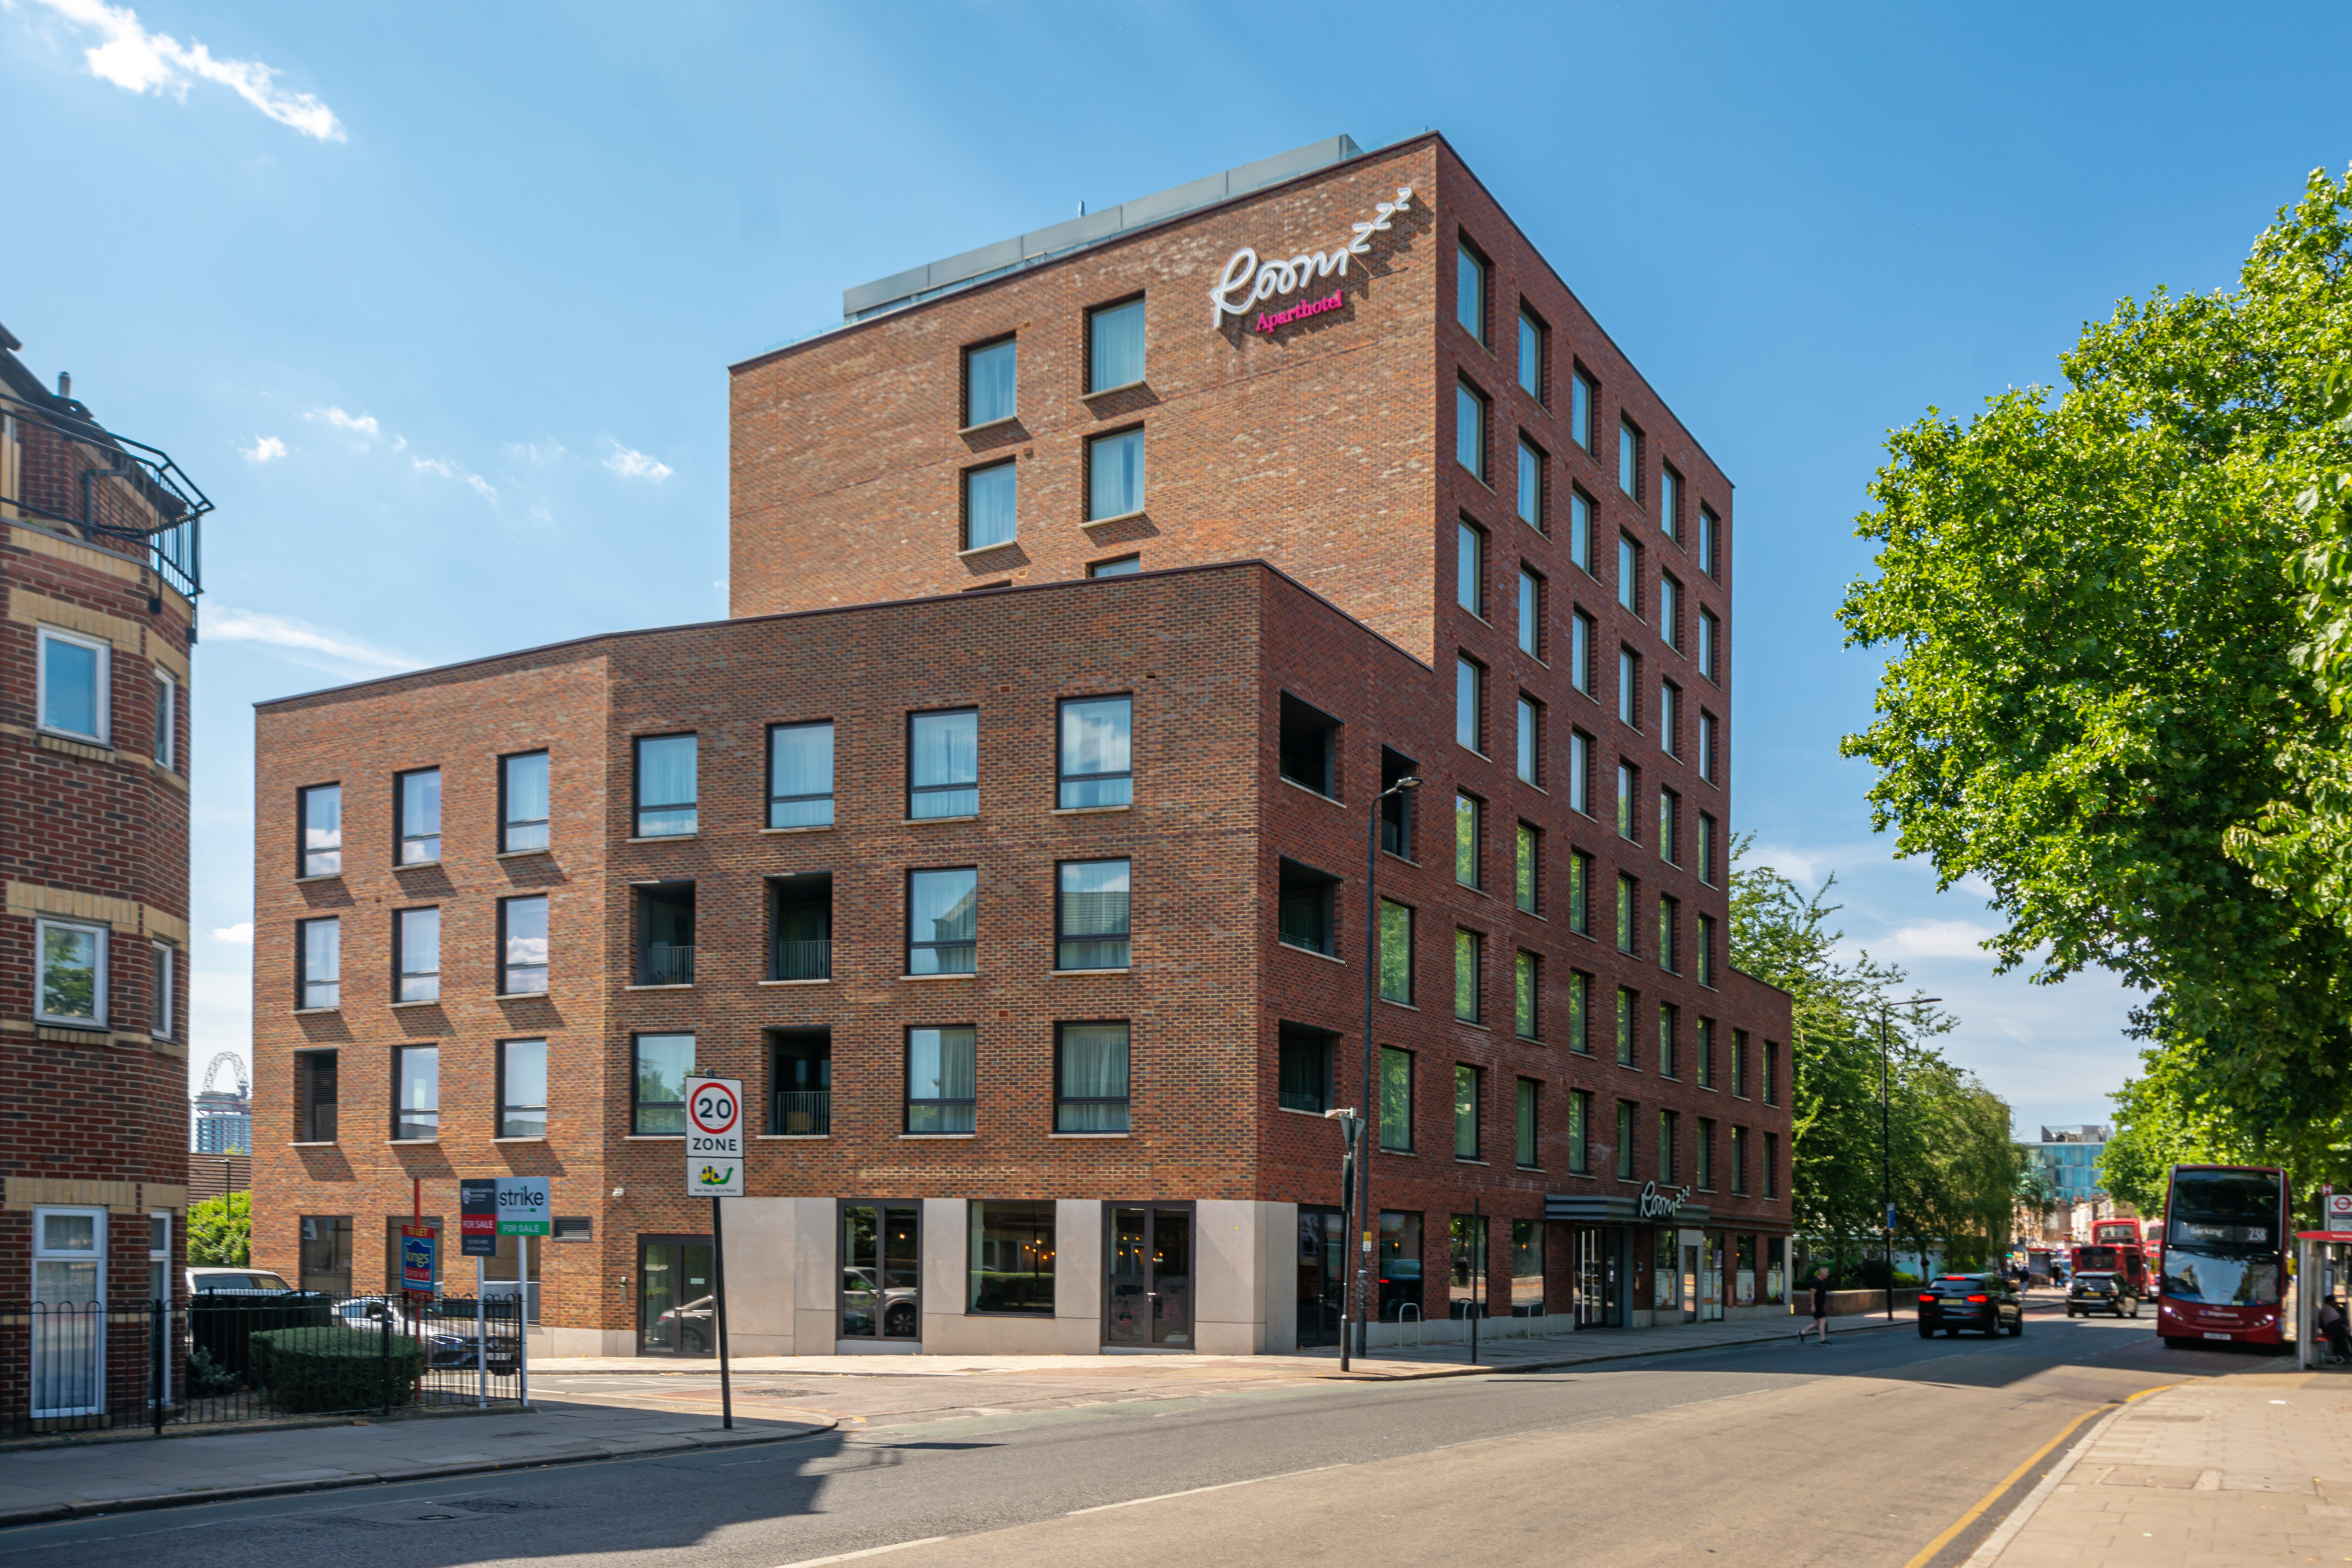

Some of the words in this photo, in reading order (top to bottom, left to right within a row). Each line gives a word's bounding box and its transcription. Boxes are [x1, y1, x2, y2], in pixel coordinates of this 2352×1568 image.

[1254, 289, 1343, 333] Aparthotel
[699, 1098, 732, 1120] 20
[692, 1138, 737, 1151] ZONE
[499, 1185, 544, 1207] strike
[2322, 1185, 2332, 1194] H
[407, 1226, 415, 1236] TO
[415, 1227, 428, 1236] LET
[463, 1220, 474, 1229] FOR
[475, 1220, 494, 1229] SALE
[2190, 1226, 2223, 1237] Barking
[2248, 1228, 2267, 1240] 238
[405, 1247, 430, 1268] kings
[405, 1269, 430, 1279] GROUP
